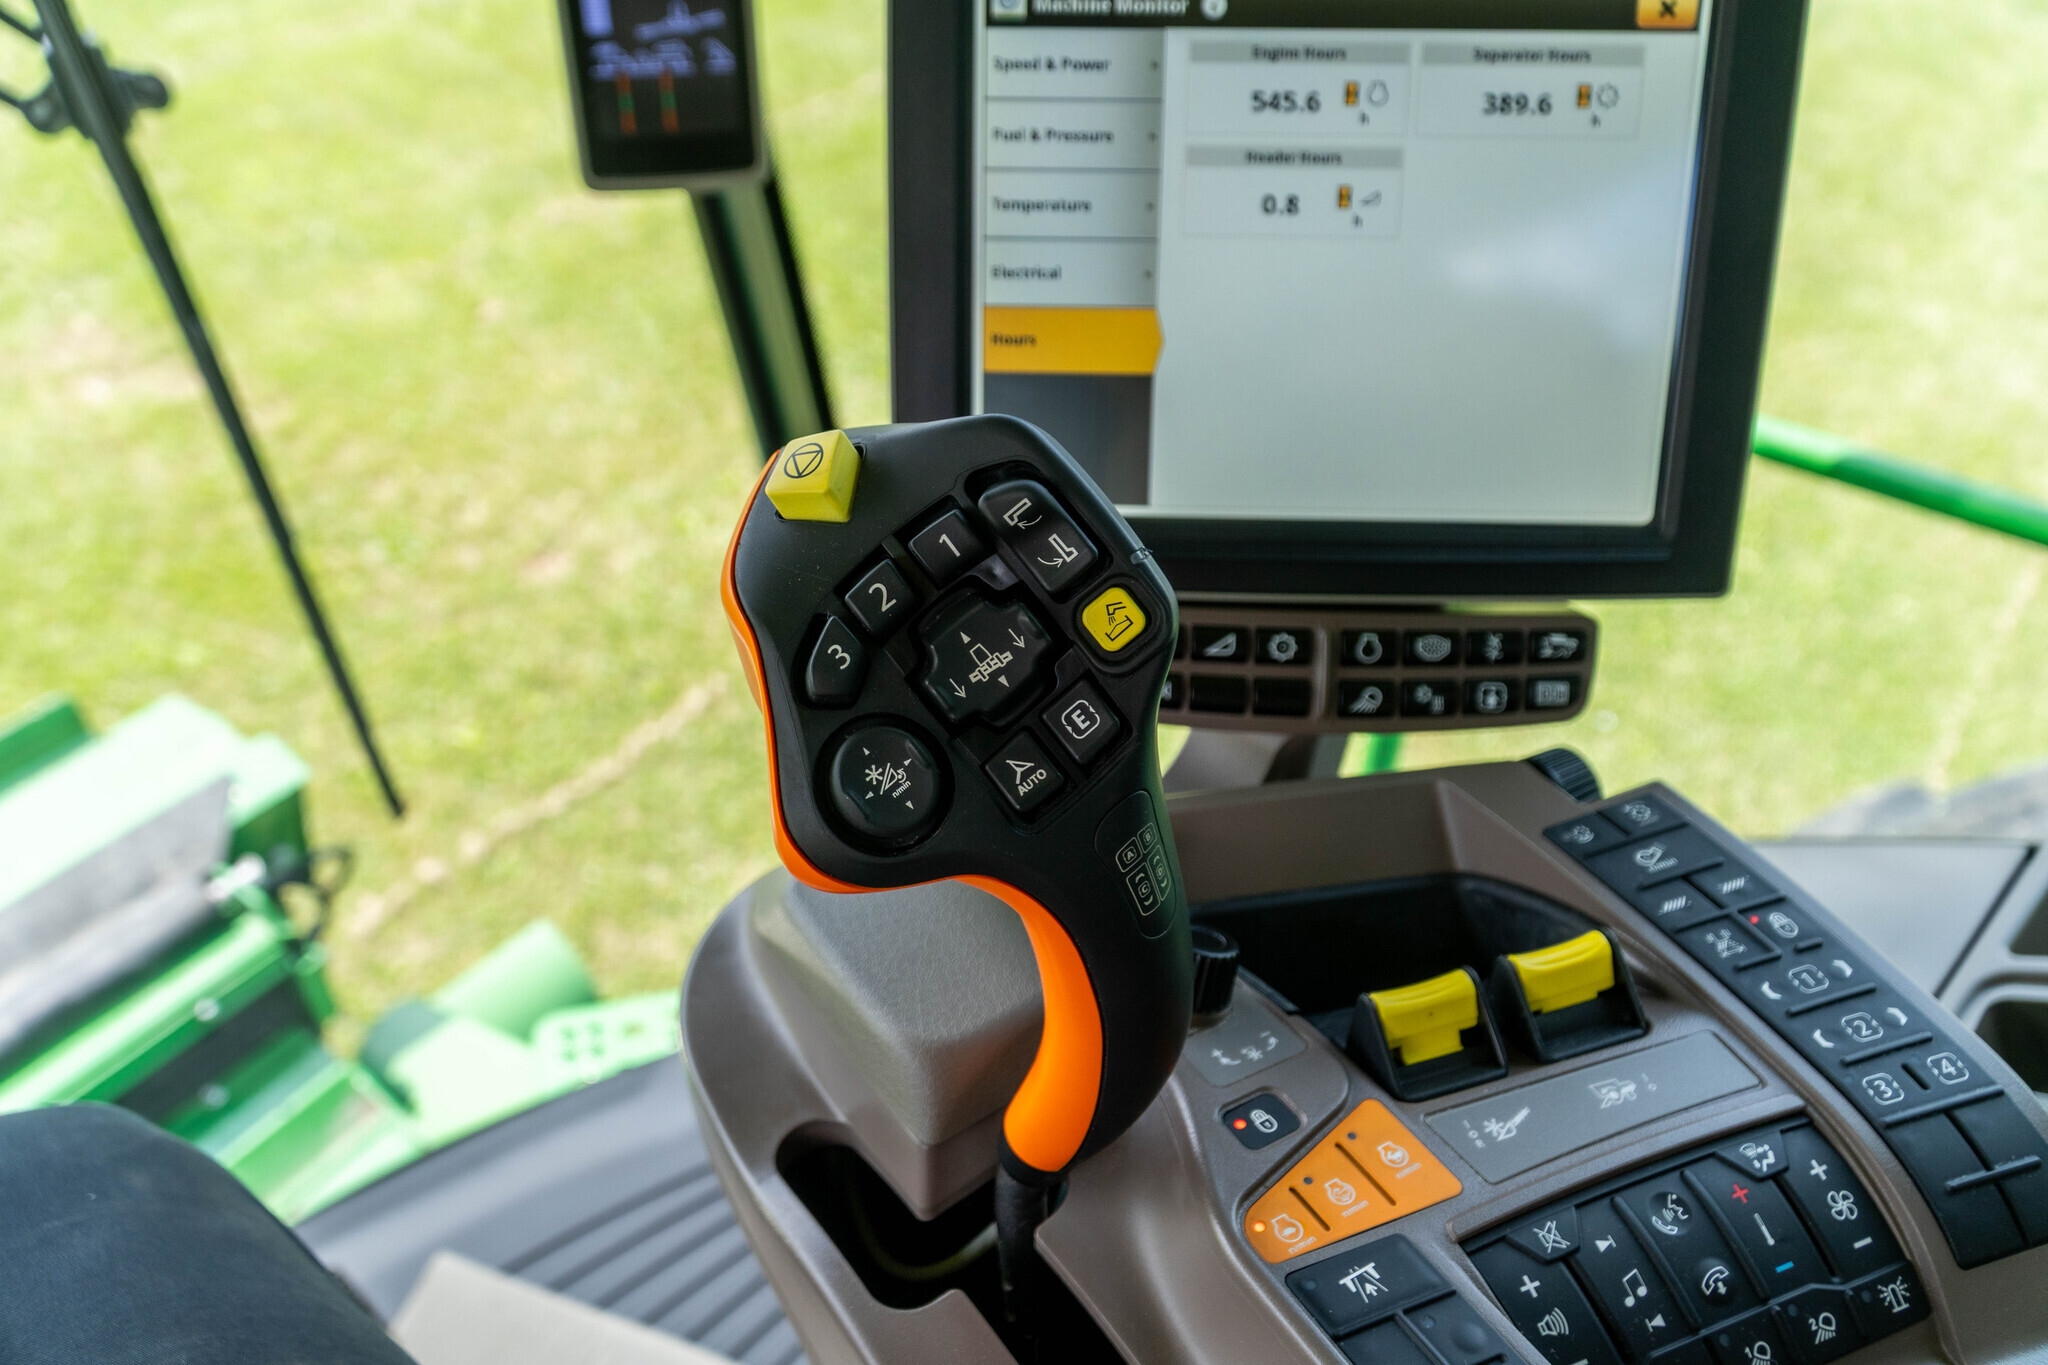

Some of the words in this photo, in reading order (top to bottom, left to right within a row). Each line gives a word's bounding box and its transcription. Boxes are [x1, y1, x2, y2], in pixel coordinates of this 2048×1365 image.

[1033, 0, 1111, 15] Machine
[1115, 0, 1190, 14] Monitor
[1252, 46, 1299, 62] Engine
[1304, 46, 1348, 60] Hours
[1472, 47, 1543, 63] Separator
[1547, 48, 1592, 62] Hours
[993, 56, 1042, 73] Speed
[1062, 56, 1111, 71] Power
[1251, 90, 1321, 112] 545.6
[1482, 92, 1552, 115] 389.6
[993, 127, 1026, 143] Fuel
[1047, 128, 1115, 144] Pressure
[1246, 151, 1295, 165] Header
[1300, 151, 1343, 165] Hours
[993, 197, 1092, 214] Temperature
[1261, 193, 1300, 216] 0.8
[991, 264, 1062, 280] Electrical
[991, 332, 1037, 346] Hours
[938, 532, 961, 558] 1
[868, 582, 898, 612] 2
[826, 642, 852, 671] 3
[1072, 708, 1090, 728] E
[891, 780, 912, 799] n/min
[1016, 768, 1048, 797] AUTO
[1852, 1019, 1873, 1037] 2
[1941, 1057, 1957, 1076] 4
[1873, 1080, 1892, 1099] 3
[1807, 1317, 1819, 1332] 2
[1743, 1345, 1753, 1359] 1
